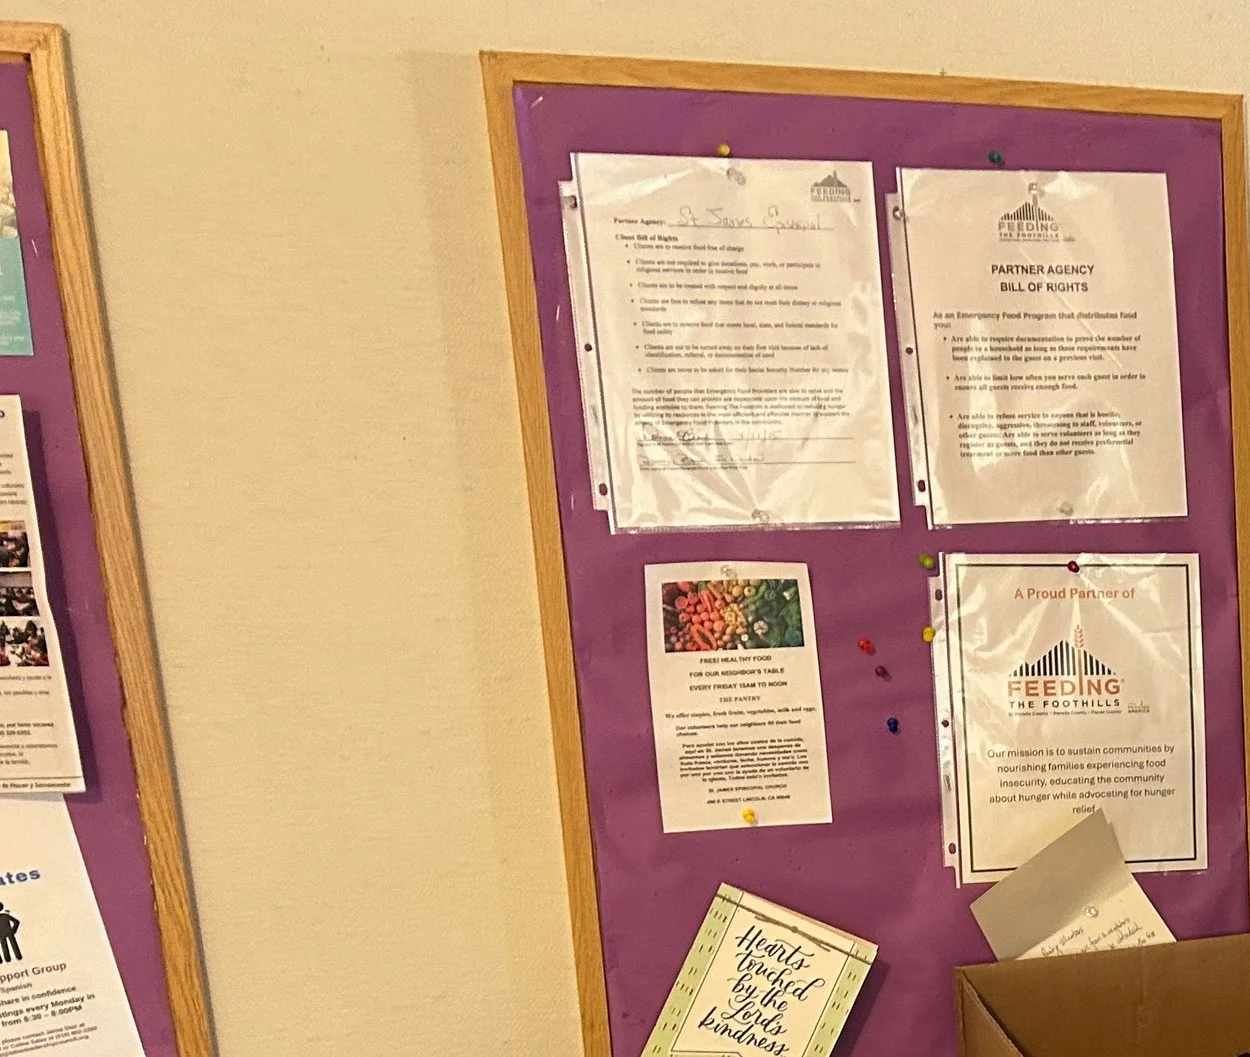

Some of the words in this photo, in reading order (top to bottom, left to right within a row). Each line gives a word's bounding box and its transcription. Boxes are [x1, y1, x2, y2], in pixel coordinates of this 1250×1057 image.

[998, 222, 1058, 232] FEEDING
[991, 264, 1044, 274] PARTNER
[1047, 264, 1093, 274] AGENCY
[1000, 282, 1025, 292] BILL
[1027, 282, 1042, 292] OF
[1046, 282, 1088, 292] RIGHTS
[1022, 312, 1056, 320] Program
[1014, 588, 1023, 599] A
[1026, 588, 1066, 600] Proud
[1069, 587, 1119, 600] Partner
[1121, 587, 1135, 599] of
[1008, 678, 1120, 696] FEEDING
[1009, 700, 1034, 708] THE
[1043, 699, 1120, 708] FOOTHILLS
[987, 749, 1005, 758] Our
[1006, 749, 1044, 758] mission
[1045, 747, 1054, 756] is
[1055, 748, 1066, 756] to
[1067, 747, 1101, 756] sustain
[1102, 746, 1162, 756] communities
[1163, 744, 1174, 754] by
[997, 763, 1047, 773] nourishing
[1047, 761, 1085, 771] families
[1085, 760, 1145, 771] experiencing
[1145, 758, 1166, 769] food
[999, 778, 1047, 788] insecurity,
[1049, 776, 1096, 786] educating
[1096, 776, 1112, 784] the
[1112, 774, 1164, 783] community
[989, 794, 1016, 803] about
[1018, 793, 1050, 803] hunger
[1052, 791, 1077, 800] while
[1078, 789, 1129, 799] advocating
[1129, 788, 1142, 797] for
[1143, 788, 1176, 797] hunger
[736, 925, 814, 971] Hearts
[32, 962, 66, 975] Group
[736, 952, 826, 1001] touched
[32, 986, 76, 1000] confidence
[727, 973, 757, 1003] by
[761, 986, 788, 1012] the
[26, 1004, 48, 1012] every
[51, 996, 84, 1008] Monday
[2, 1018, 22, 1027] from
[721, 998, 787, 1036] Lord's
